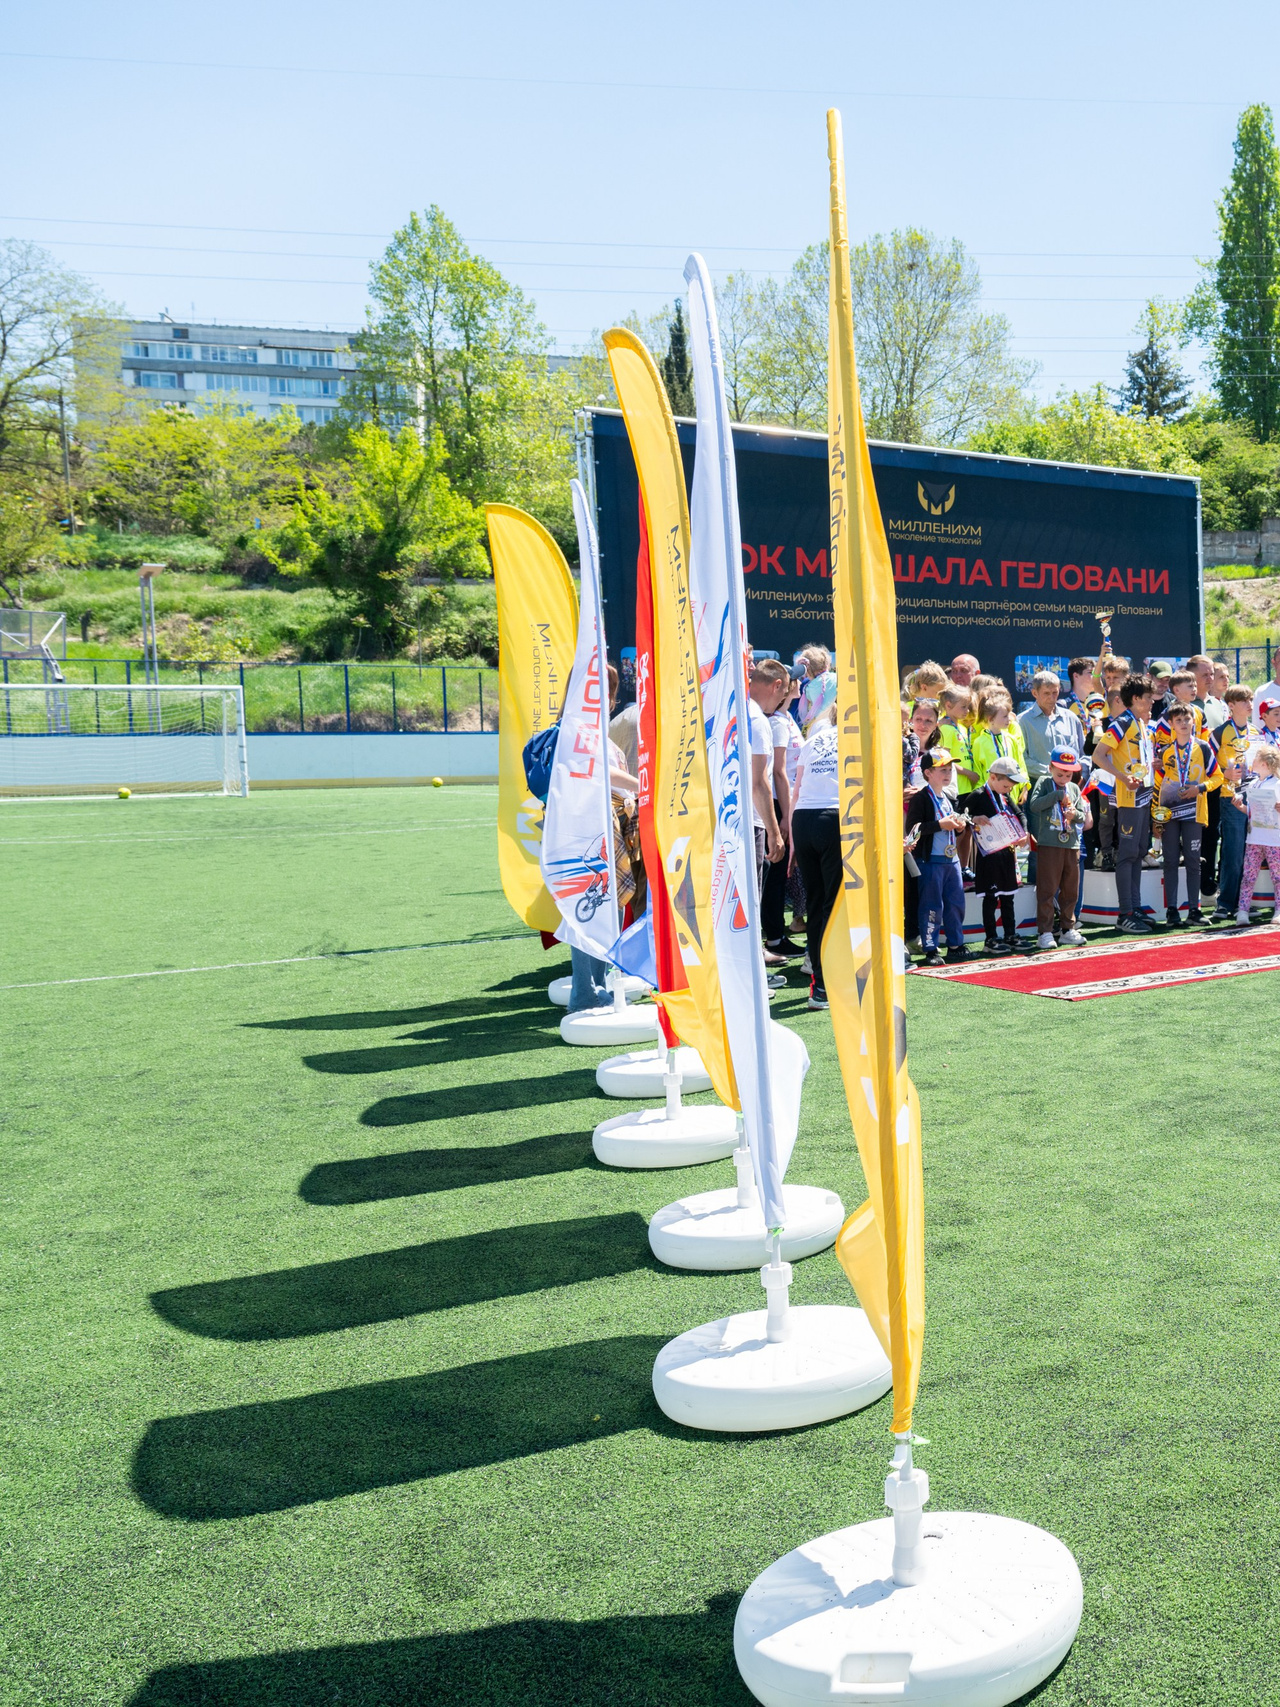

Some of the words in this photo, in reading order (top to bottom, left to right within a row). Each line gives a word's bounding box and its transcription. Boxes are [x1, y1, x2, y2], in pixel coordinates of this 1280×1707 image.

[889, 519, 982, 536] МИЛЛЕНИУМ
[889, 532, 936, 543] поколение
[937, 536, 982, 546] технологий
[796, 547, 993, 587] МШАЛА
[1001, 560, 1170, 595] ГЕЛОВАНИ
[970, 600, 1031, 613] партнёром
[1033, 603, 1066, 613] семьи
[1068, 604, 1115, 615] маршала
[1117, 604, 1163, 615] Геловани
[769, 609, 778, 619] и
[931, 614, 1011, 628] исторической
[1013, 618, 1052, 628] памяти
[1053, 619, 1061, 628] о
[1062, 617, 1084, 629] нём
